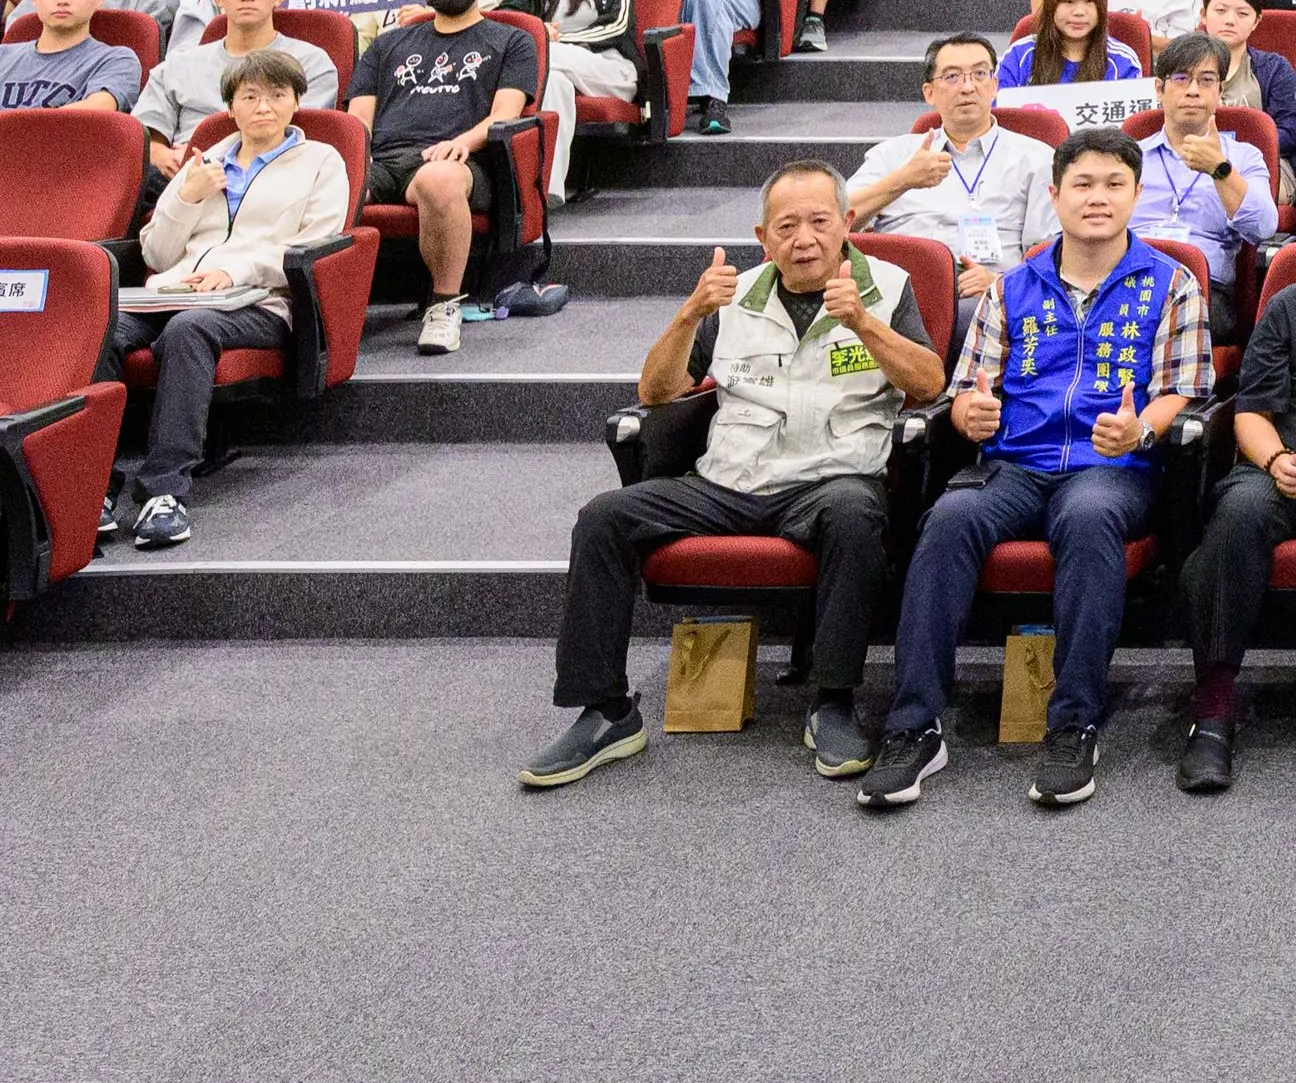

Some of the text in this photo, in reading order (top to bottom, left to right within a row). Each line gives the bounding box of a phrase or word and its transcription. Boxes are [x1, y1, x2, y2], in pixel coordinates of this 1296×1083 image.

[1075, 98, 1164, 125] 交通運
[1042, 298, 1058, 337] 副主任
